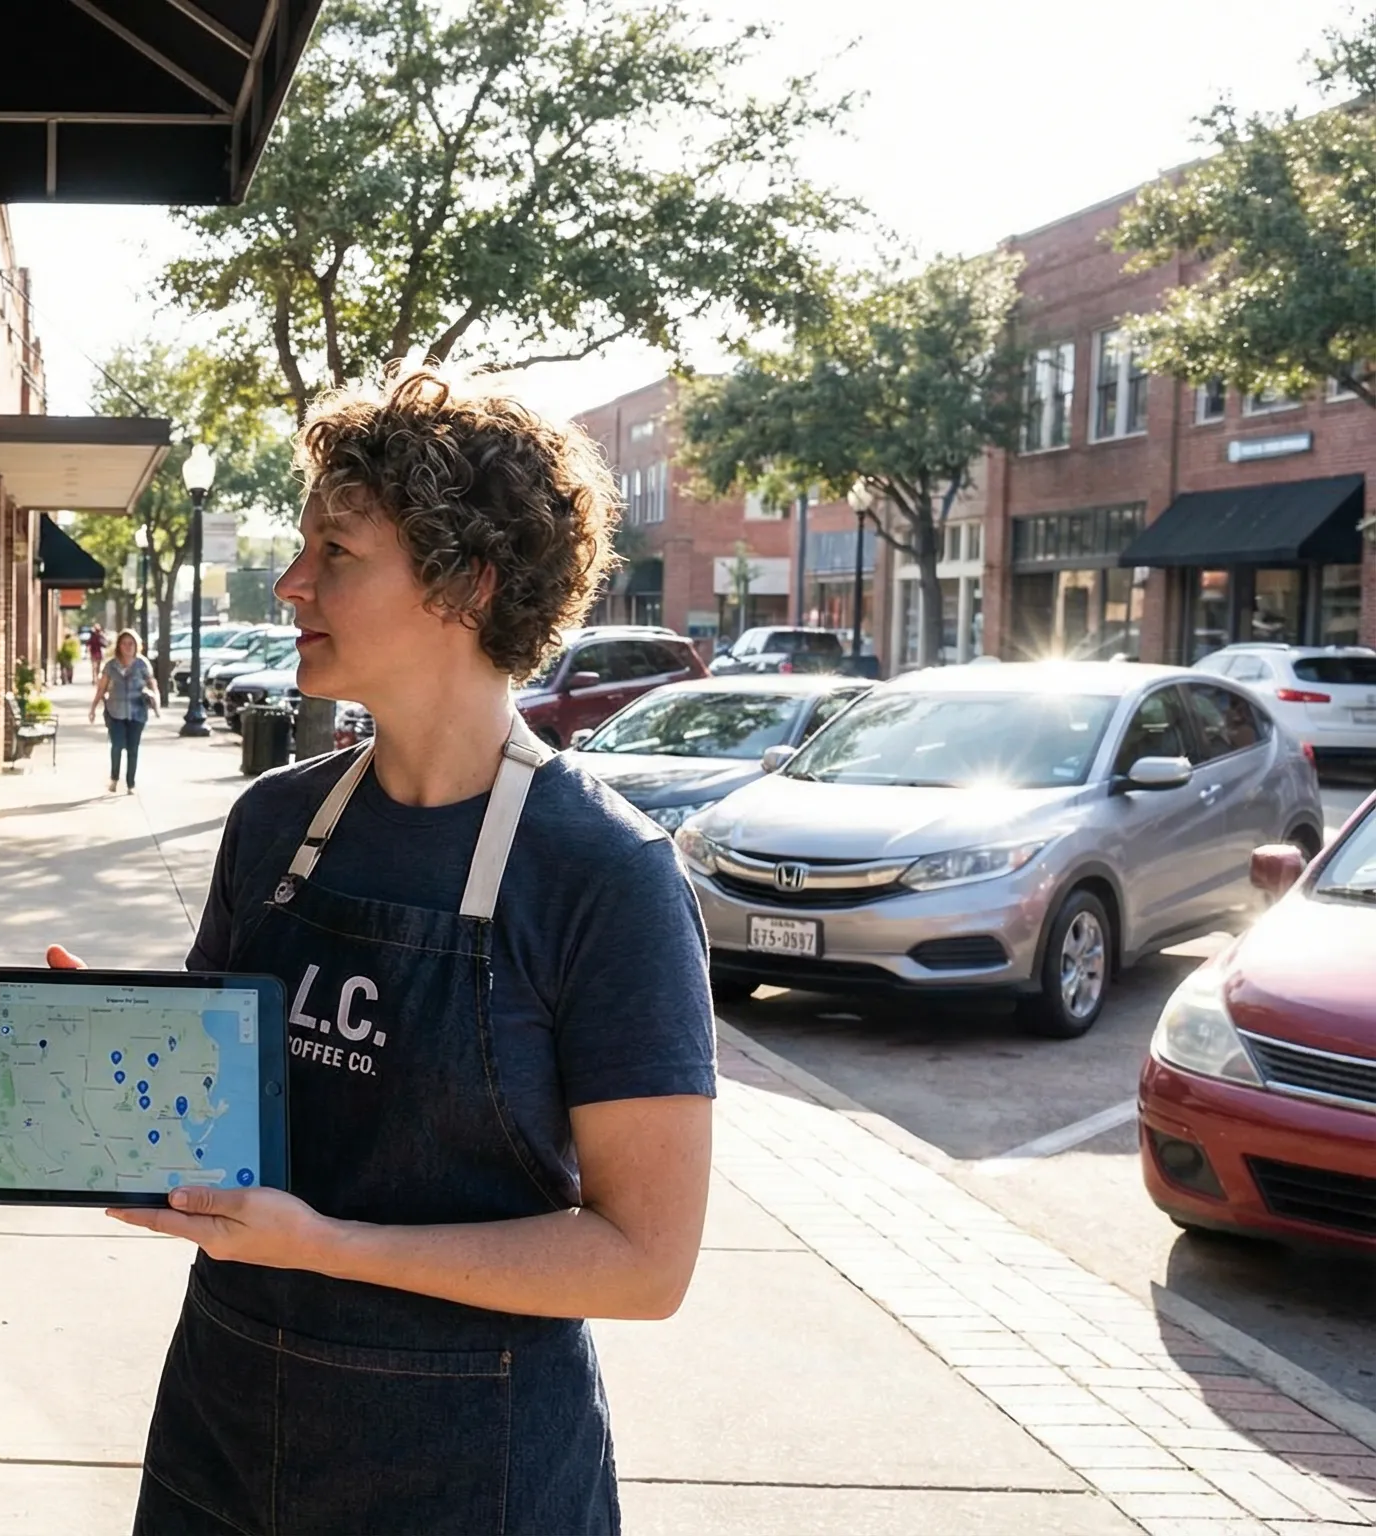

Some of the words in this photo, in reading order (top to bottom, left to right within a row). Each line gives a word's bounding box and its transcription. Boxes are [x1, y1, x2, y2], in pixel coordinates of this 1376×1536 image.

[289, 963, 387, 1047] L.C.
[289, 1035, 344, 1068] OFFEE
[348, 1051, 376, 1076] CO.
